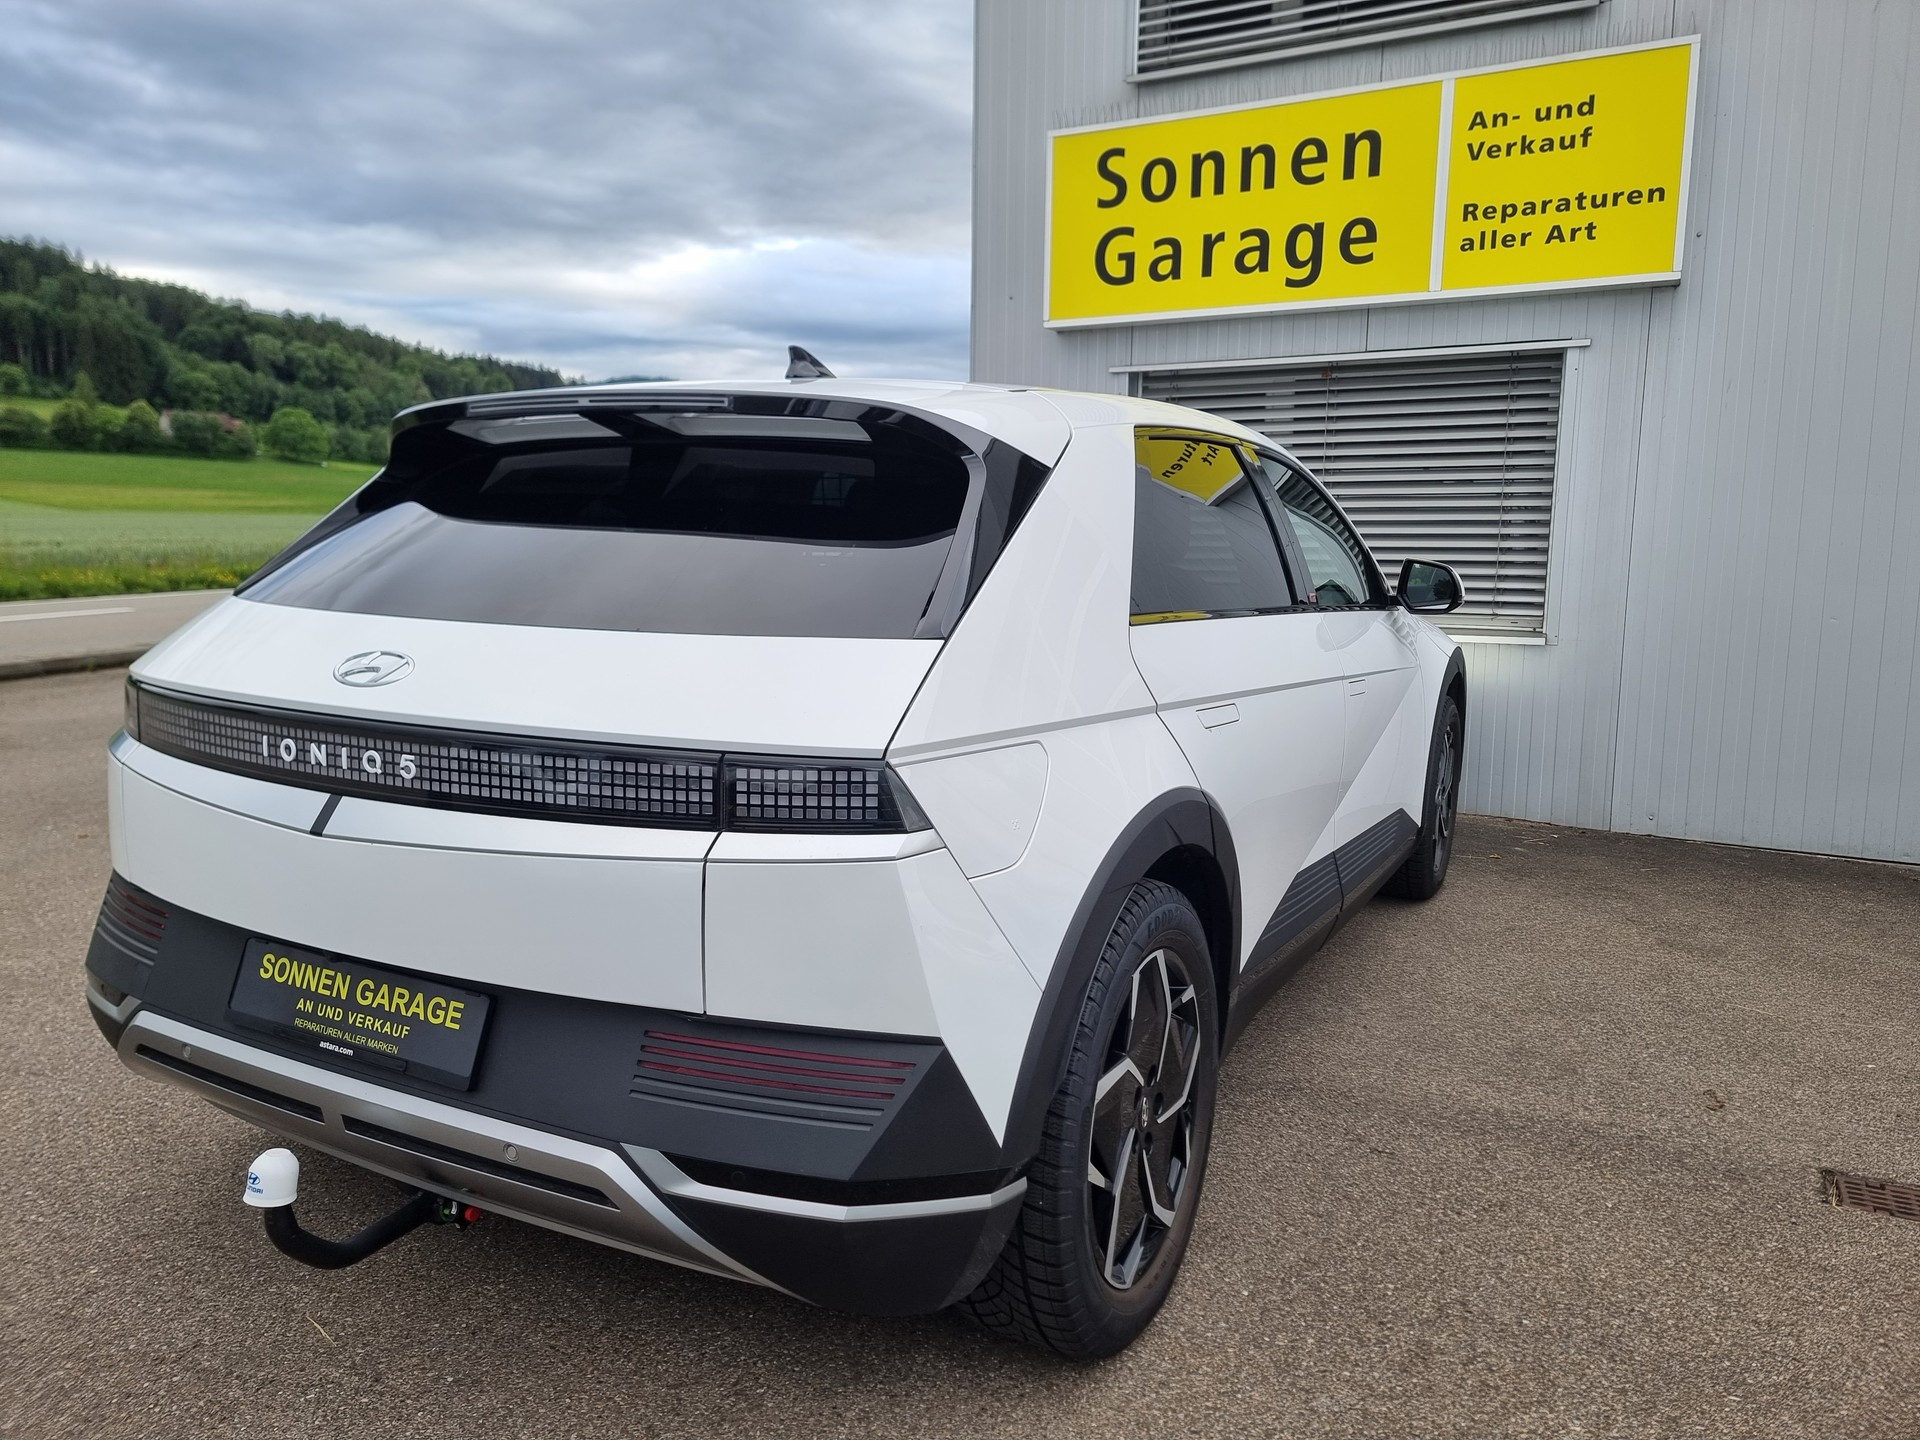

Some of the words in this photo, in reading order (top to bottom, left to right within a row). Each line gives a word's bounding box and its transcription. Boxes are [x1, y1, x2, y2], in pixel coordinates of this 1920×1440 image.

[1468, 111, 1521, 131] An-
[1535, 94, 1596, 123] und
[1467, 126, 1593, 161] Verkauf
[1097, 129, 1382, 209] Sonnen
[1462, 186, 1666, 224] Reparaturen
[1094, 217, 1378, 289] Garage
[1459, 229, 1532, 252] aller
[1544, 221, 1597, 246] Art
[262, 735, 382, 775] IONIQ
[399, 754, 417, 780] 5
[260, 953, 351, 1000] SONNEN
[356, 979, 465, 1029] GARAGE
[294, 1017, 344, 1039] REPARATUREN
[343, 1031, 367, 1046] ALLER
[367, 1038, 399, 1055] MARKEN
[296, 997, 314, 1013] AN
[317, 1003, 343, 1021] UND
[348, 1011, 411, 1039] VERKAUF
[319, 1040, 354, 1056] astara.com
